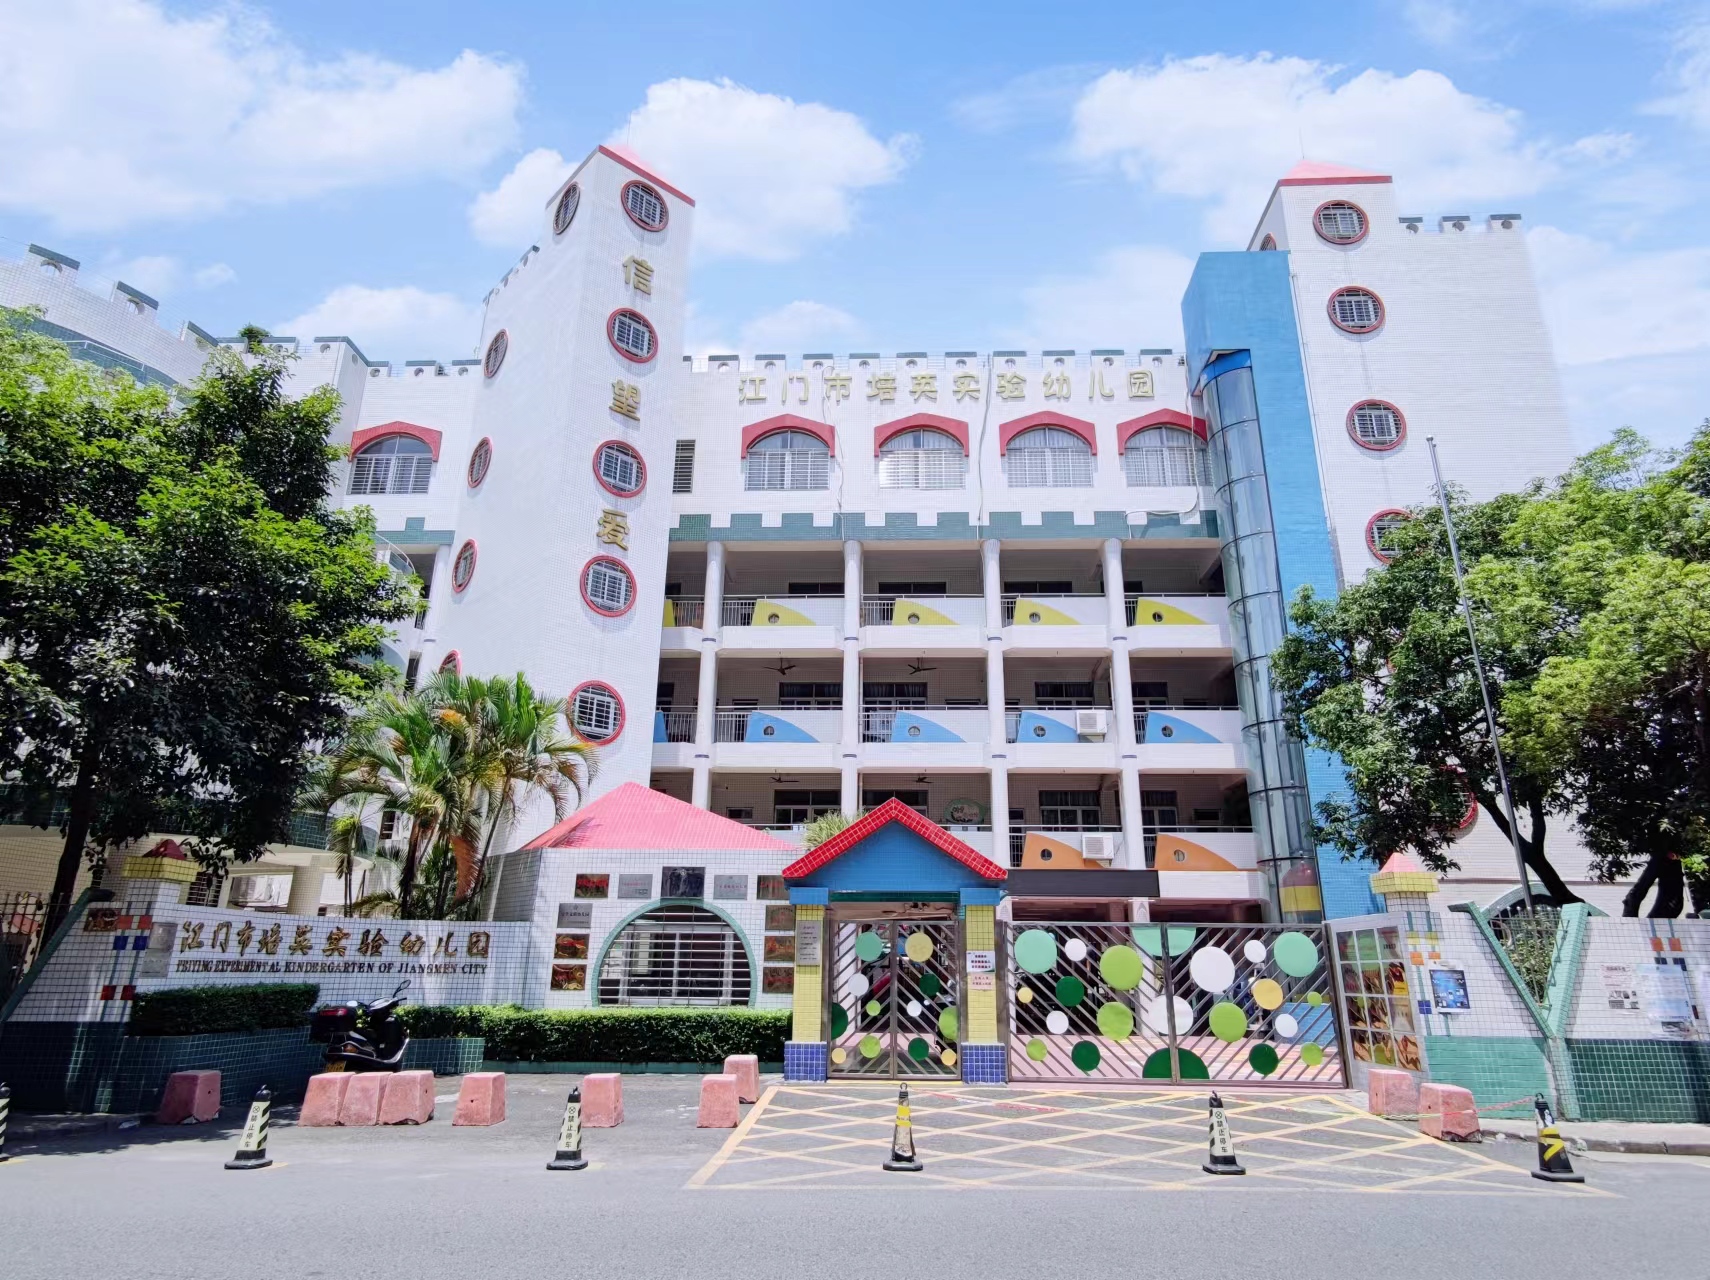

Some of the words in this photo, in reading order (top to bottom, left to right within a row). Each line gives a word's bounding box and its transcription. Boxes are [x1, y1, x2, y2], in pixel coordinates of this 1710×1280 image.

[738, 370, 1157, 404] 江门市培英实验幼儿园
[213, 959, 281, 973] EXPERIMENTAL
[284, 961, 374, 974] KINDERGARTEN
[378, 962, 394, 974] OF
[397, 962, 457, 974] JIANGMEN
[461, 963, 488, 975] CITY
[244, 1114, 258, 1148] 禁止停车
[565, 1115, 575, 1149] 禁止停车
[1216, 1120, 1229, 1153] 禁止停车
